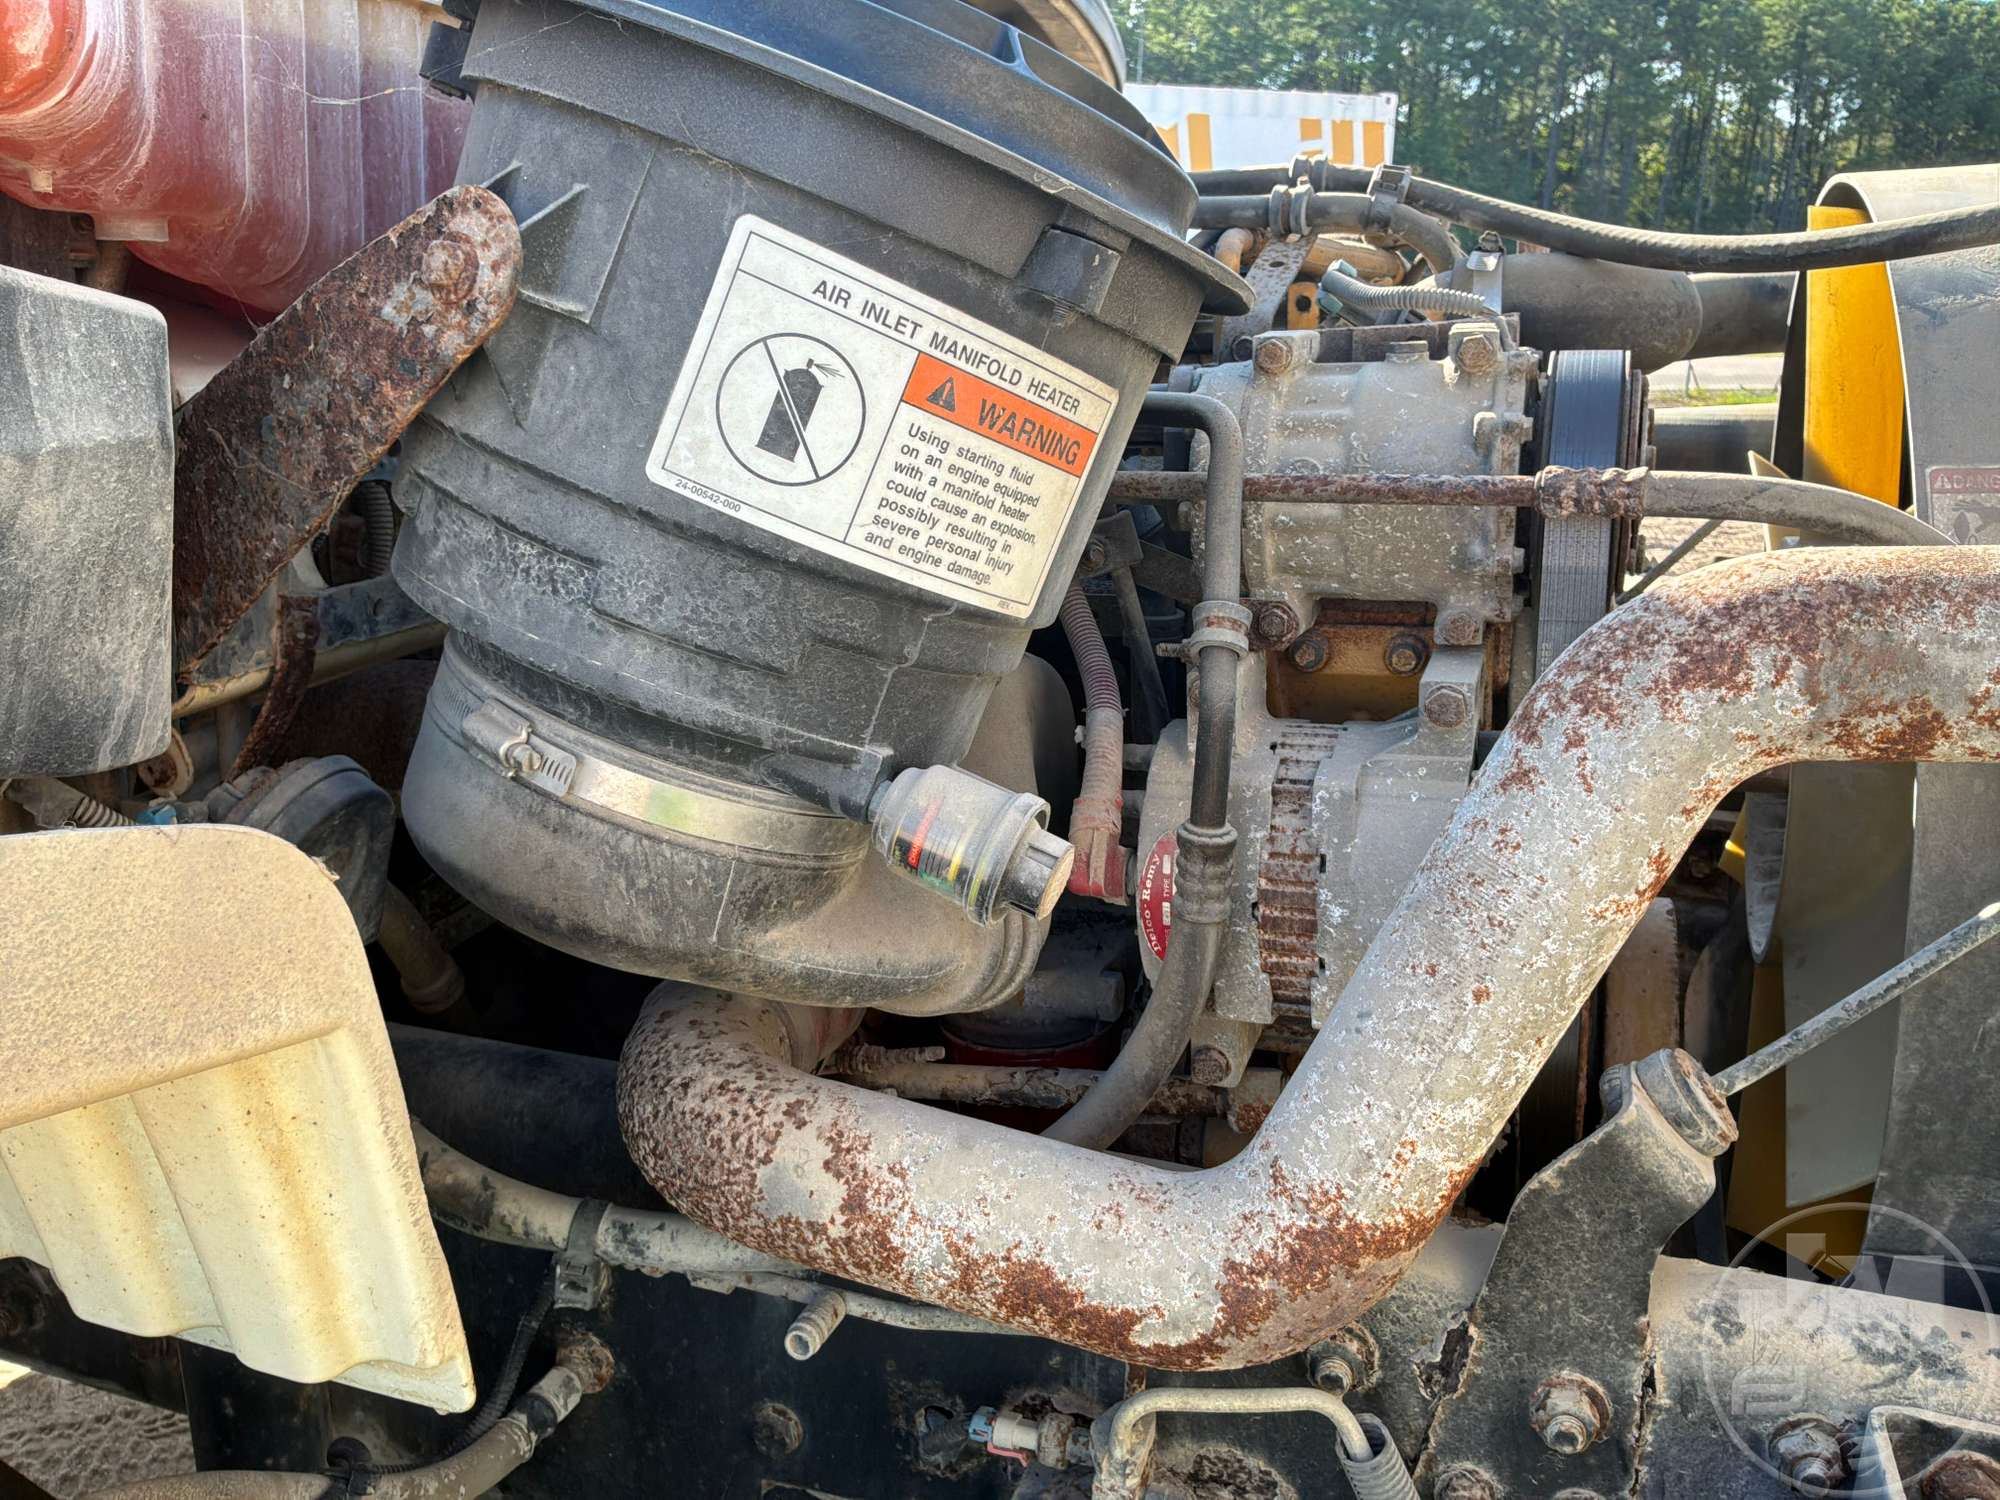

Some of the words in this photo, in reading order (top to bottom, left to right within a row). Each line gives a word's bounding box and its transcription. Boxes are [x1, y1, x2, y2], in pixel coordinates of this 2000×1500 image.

[812, 279, 852, 309] AIR
[860, 299, 923, 341] INLET
[928, 331, 1023, 388] MANIFOLD
[1027, 376, 1081, 416] HEATER
[909, 422, 950, 454] Using
[956, 445, 1005, 477] starting
[1010, 465, 1035, 487] fluid
[978, 398, 1081, 467] WARNING
[674, 478, 742, 514] 24-00542-000
[886, 479, 927, 503] could
[930, 496, 968, 519] cause
[971, 512, 988, 527] an
[893, 460, 924, 482] with
[928, 475, 938, 488] a
[942, 480, 997, 510] manifold
[1000, 500, 1030, 523] heater
[900, 443, 920, 460] on
[924, 453, 943, 469] an
[947, 462, 990, 488] engine
[993, 483, 1041, 508] equipped
[864, 529, 894, 550] and
[898, 544, 943, 568] engine
[872, 514, 920, 541] severe
[925, 533, 981, 562] personal
[984, 553, 1014, 577] injury
[877, 496, 940, 531] possibly
[945, 522, 998, 552] resulting
[1001, 540, 1013, 554] in
